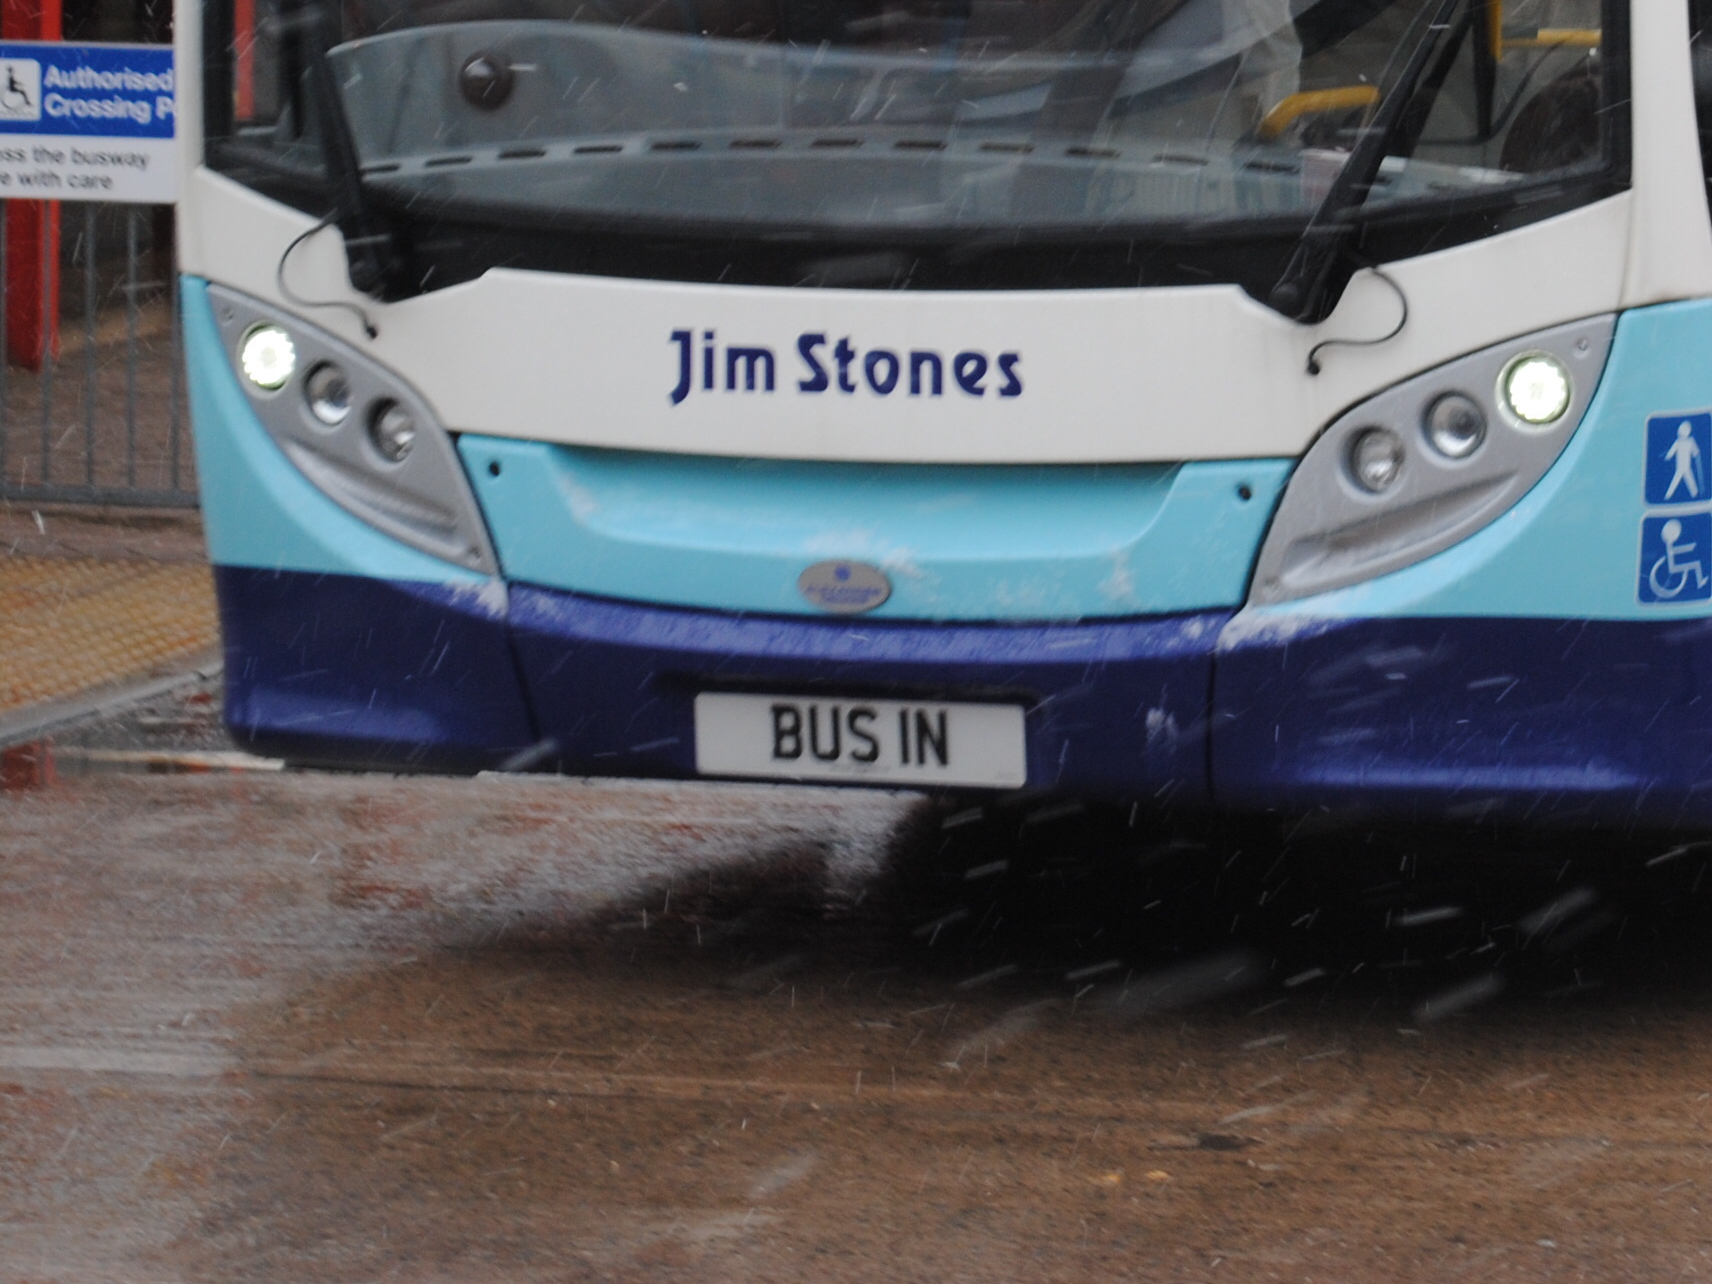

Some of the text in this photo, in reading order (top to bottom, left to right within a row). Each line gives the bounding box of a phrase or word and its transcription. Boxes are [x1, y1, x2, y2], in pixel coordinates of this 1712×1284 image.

[44, 92, 152, 124] Crossing
[32, 145, 65, 164] the
[71, 146, 148, 171] busway
[68, 173, 114, 189] care
[668, 327, 1023, 407] Jim Stones
[771, 704, 879, 762] BUS
